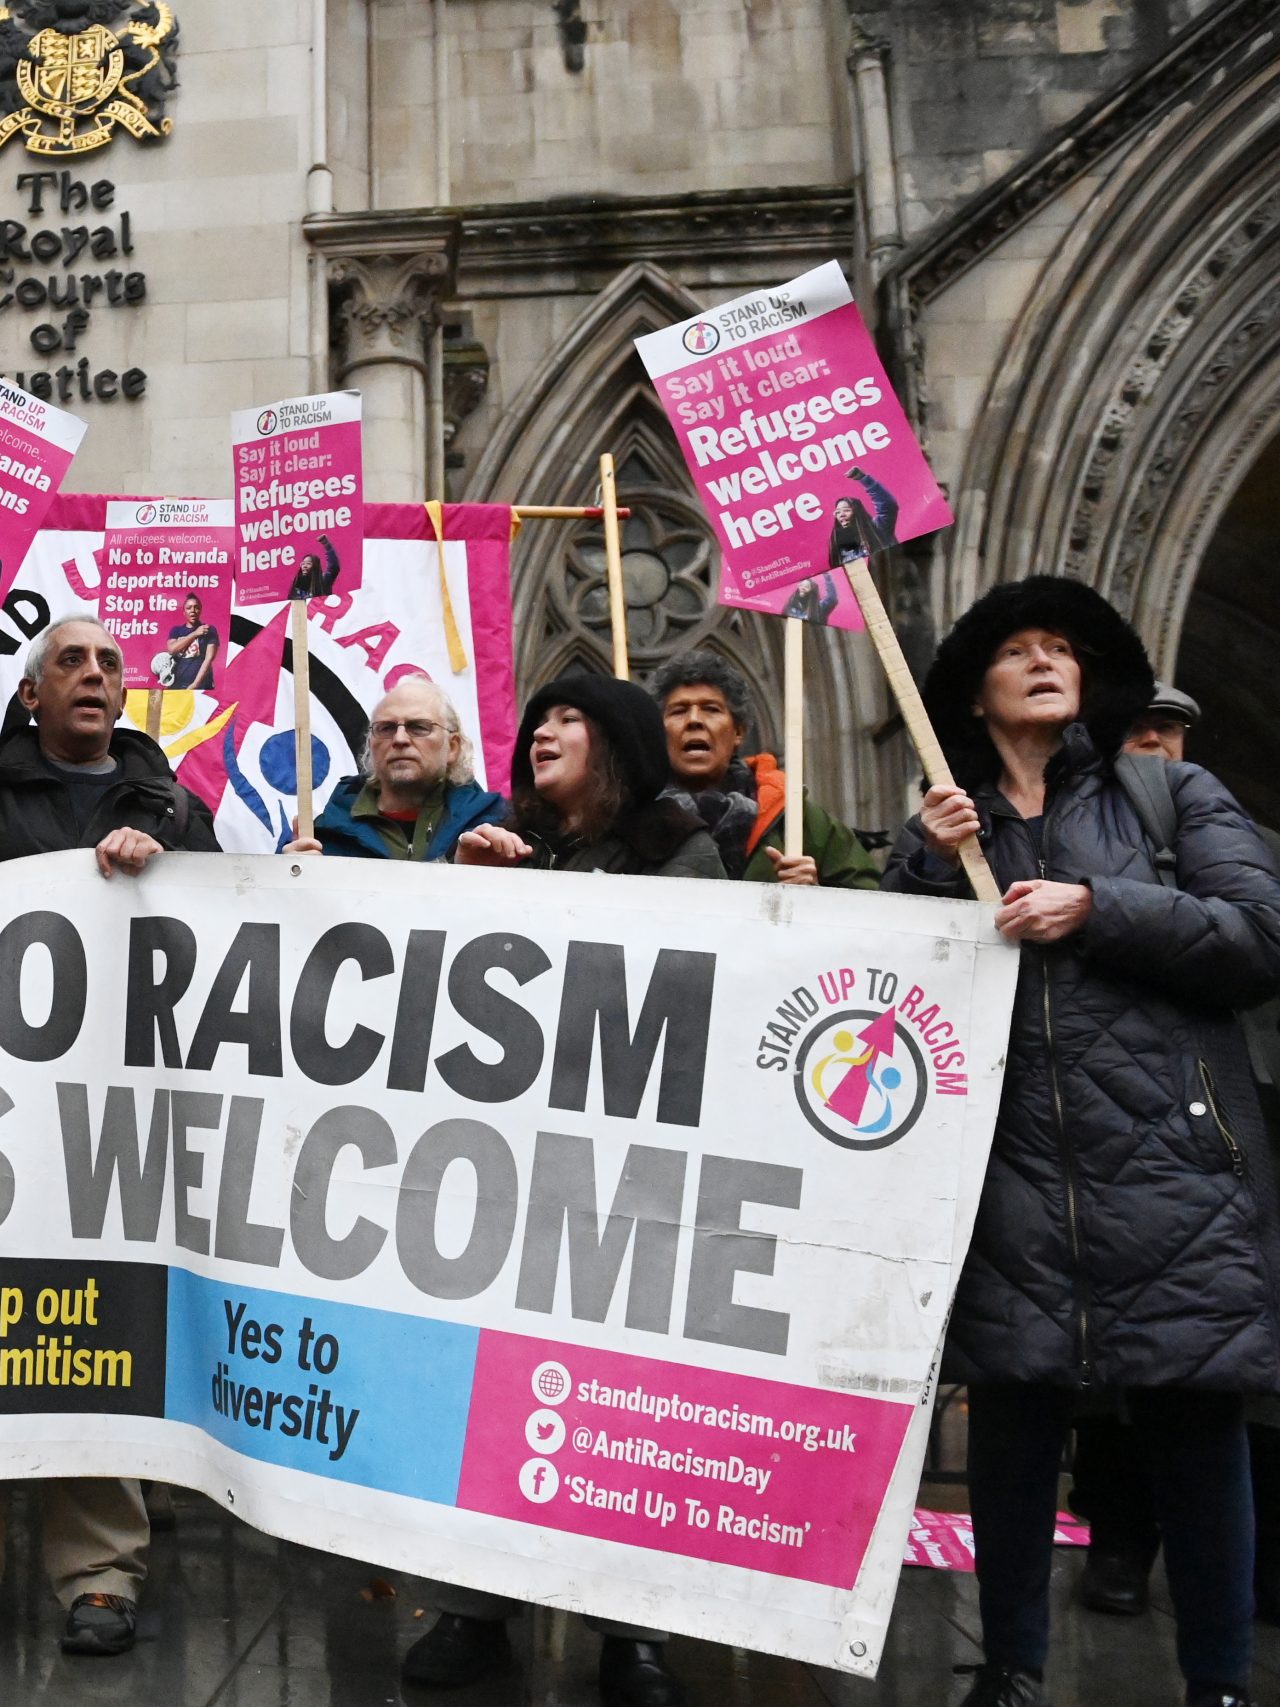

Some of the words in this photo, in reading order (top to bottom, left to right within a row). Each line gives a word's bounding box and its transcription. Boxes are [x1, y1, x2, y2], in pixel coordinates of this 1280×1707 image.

[16, 170, 116, 213] The
[719, 299, 768, 328] STAND
[769, 292, 791, 310] UP
[725, 326, 747, 342] TO
[750, 302, 807, 335] RACISM
[30, 307, 90, 353] of
[666, 371, 715, 399] Say
[720, 358, 742, 382] it
[743, 335, 802, 372] loud
[29, 402, 45, 416] UP
[280, 406, 309, 417] STAND
[312, 401, 327, 412] UP
[677, 394, 726, 425] Say
[730, 384, 754, 407] it
[758, 359, 831, 397] clear:
[0, 402, 45, 431] RACISM
[280, 418, 291, 429] TO
[294, 411, 331, 427] RACISM
[687, 376, 882, 468] Refugees
[239, 447, 265, 464] Say
[270, 441, 280, 457] it
[285, 432, 319, 452] loud
[705, 422, 891, 506] welcome
[240, 467, 266, 483] Say
[270, 460, 280, 477] it
[285, 454, 332, 474] clear:
[240, 474, 356, 513] Refugees
[160, 514, 170, 522] TO
[173, 514, 208, 522] RACISM
[240, 506, 351, 543] welcome
[719, 492, 823, 549] here
[109, 549, 131, 565] No
[136, 551, 154, 564] to
[159, 547, 228, 564] Rwanda
[110, 534, 122, 544] All
[124, 534, 164, 546] refugees
[240, 545, 295, 573] here
[107, 572, 219, 592] deportations
[105, 595, 144, 615] Stop
[149, 595, 178, 611] the
[105, 619, 158, 639] flights
[123, 915, 717, 1128] RACISM
[756, 985, 820, 1072] STAND
[818, 968, 856, 1004] UP
[867, 968, 899, 1005] TO
[898, 984, 969, 1096] RACISM
[55, 1081, 803, 1356] WELCOME
[37, 1278, 99, 1326] out
[223, 1299, 284, 1364] Yes
[297, 1317, 339, 1376] to
[211, 1362, 360, 1461] diversity
[576, 1377, 856, 1454] standuptoracism.org.uk
[572, 1426, 772, 1496] @AntiRacismDay
[644, 1490, 678, 1525] Up
[684, 1499, 711, 1529] To
